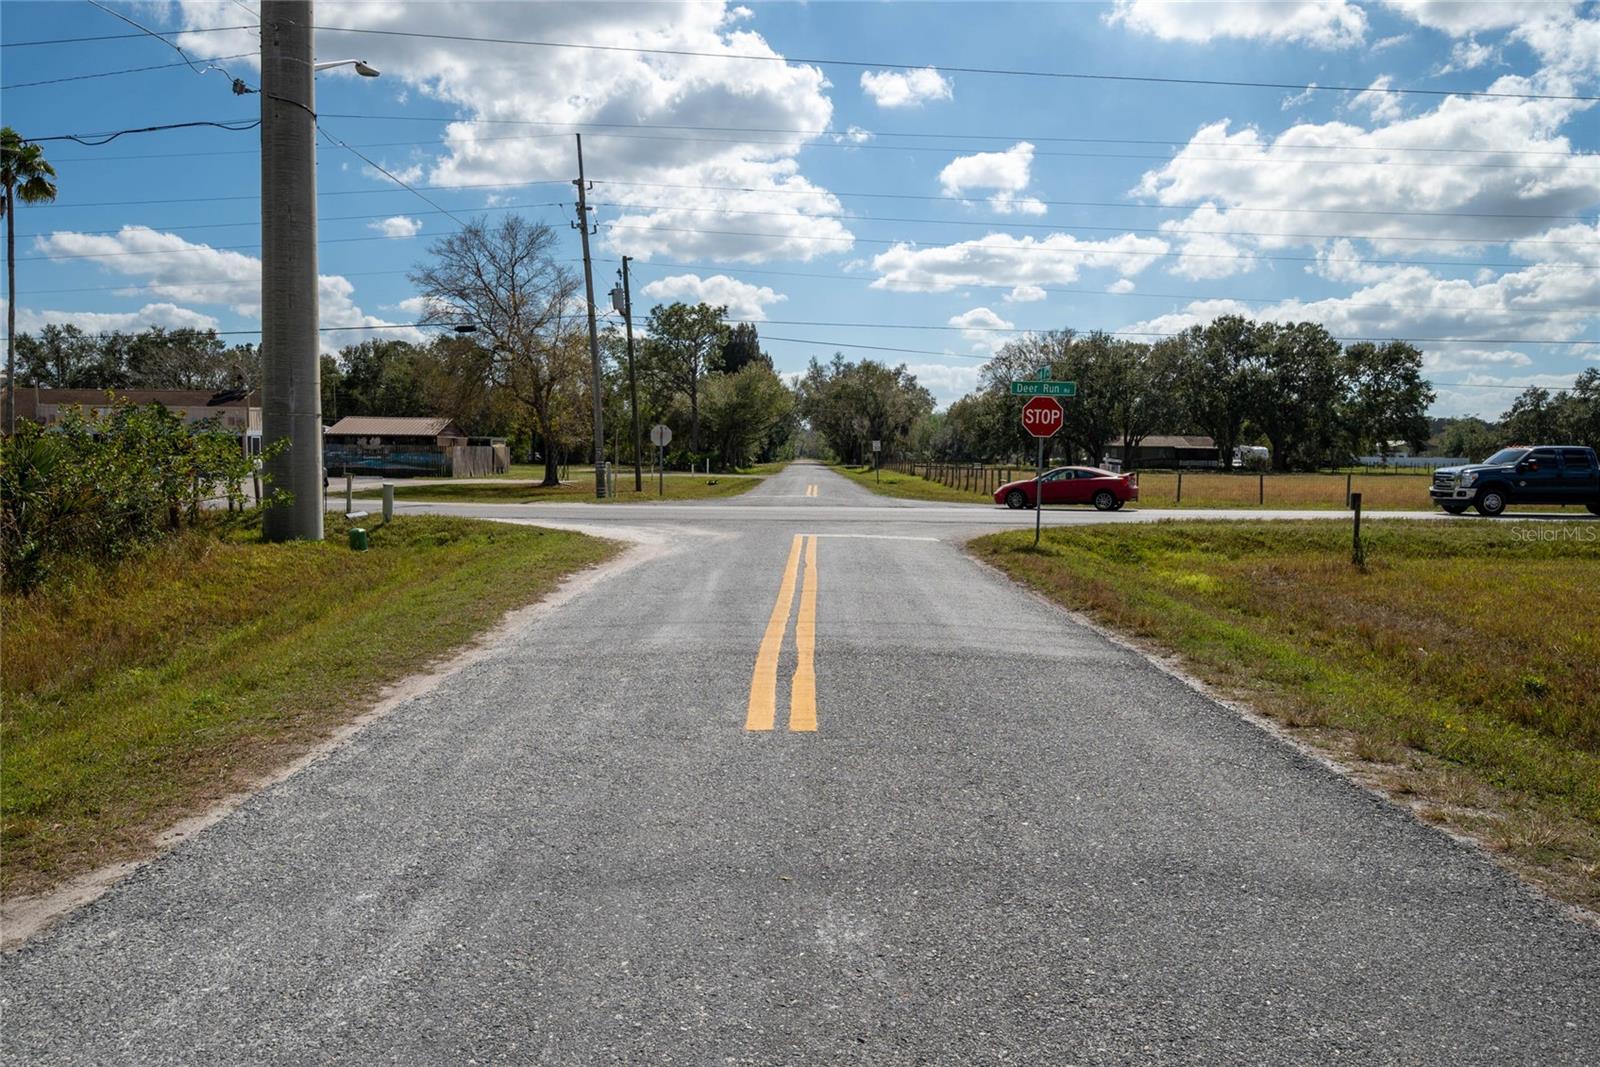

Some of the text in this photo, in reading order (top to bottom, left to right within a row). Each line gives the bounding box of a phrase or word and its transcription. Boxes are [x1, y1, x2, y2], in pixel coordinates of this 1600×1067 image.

[1017, 384, 1038, 393] Deer
[1043, 384, 1060, 393] Run
[1025, 409, 1060, 424] STOP
